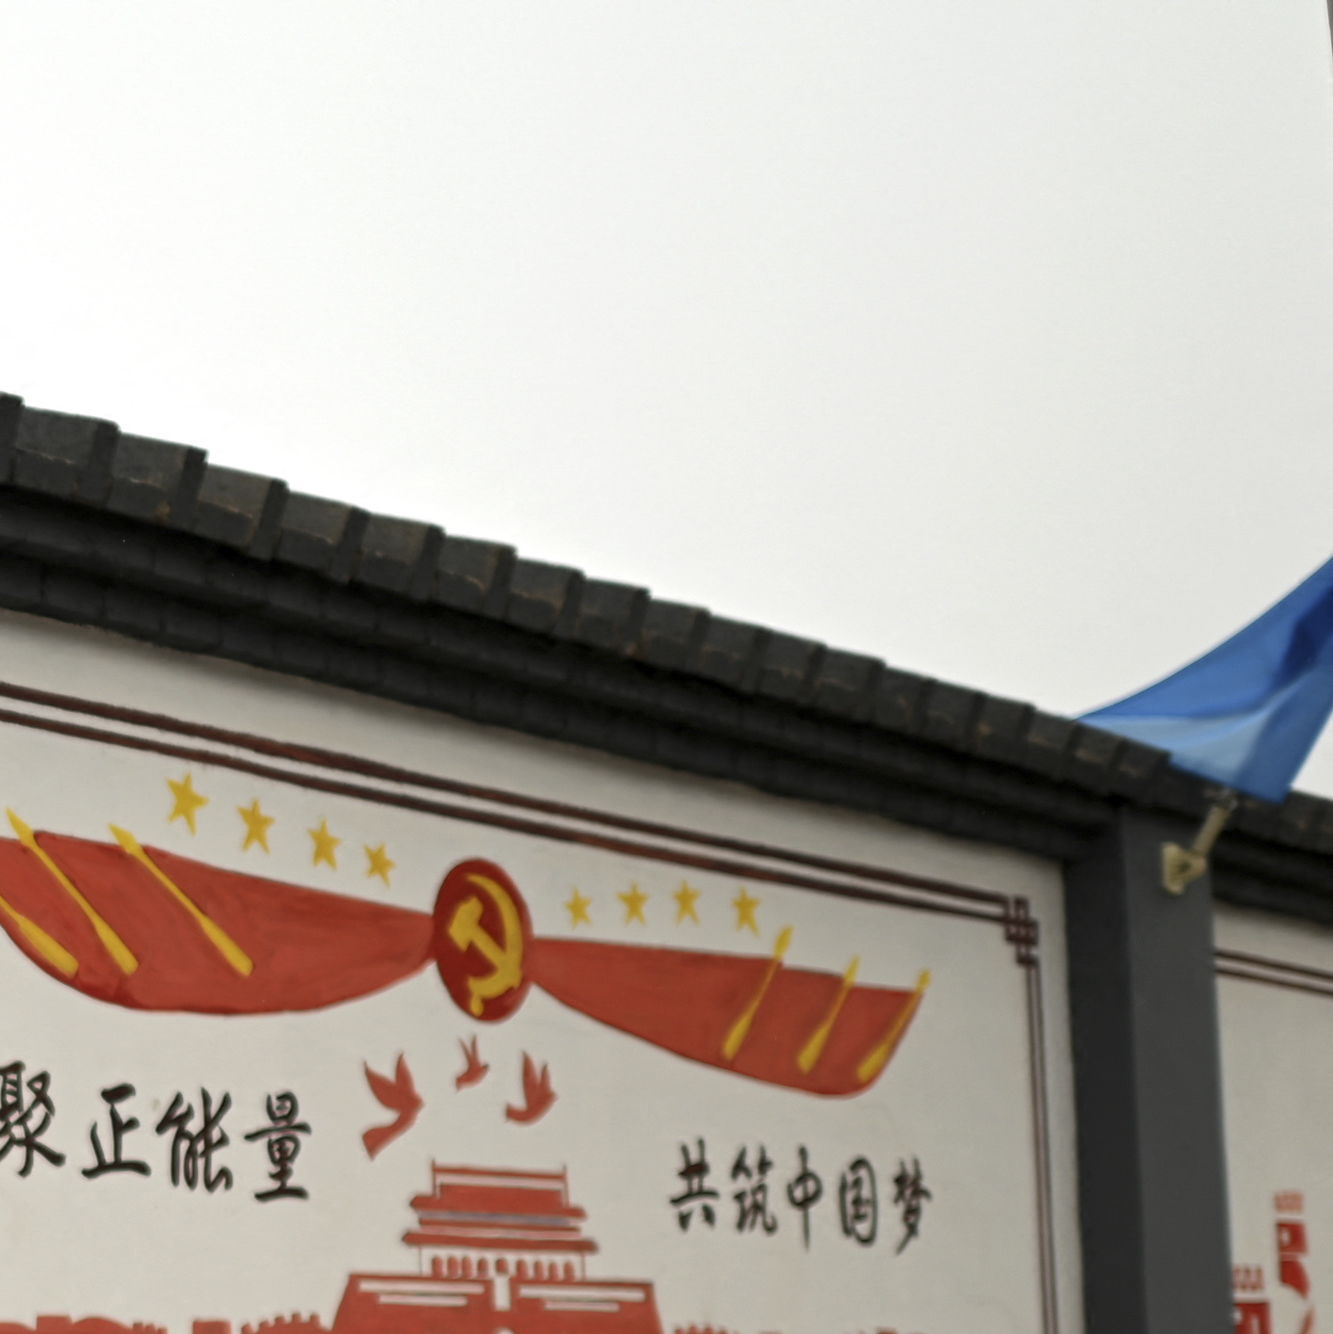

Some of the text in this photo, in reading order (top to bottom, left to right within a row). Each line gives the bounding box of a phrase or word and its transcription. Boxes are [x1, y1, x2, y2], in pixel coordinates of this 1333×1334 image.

[670, 1136, 932, 1256] 共筑中国梦
